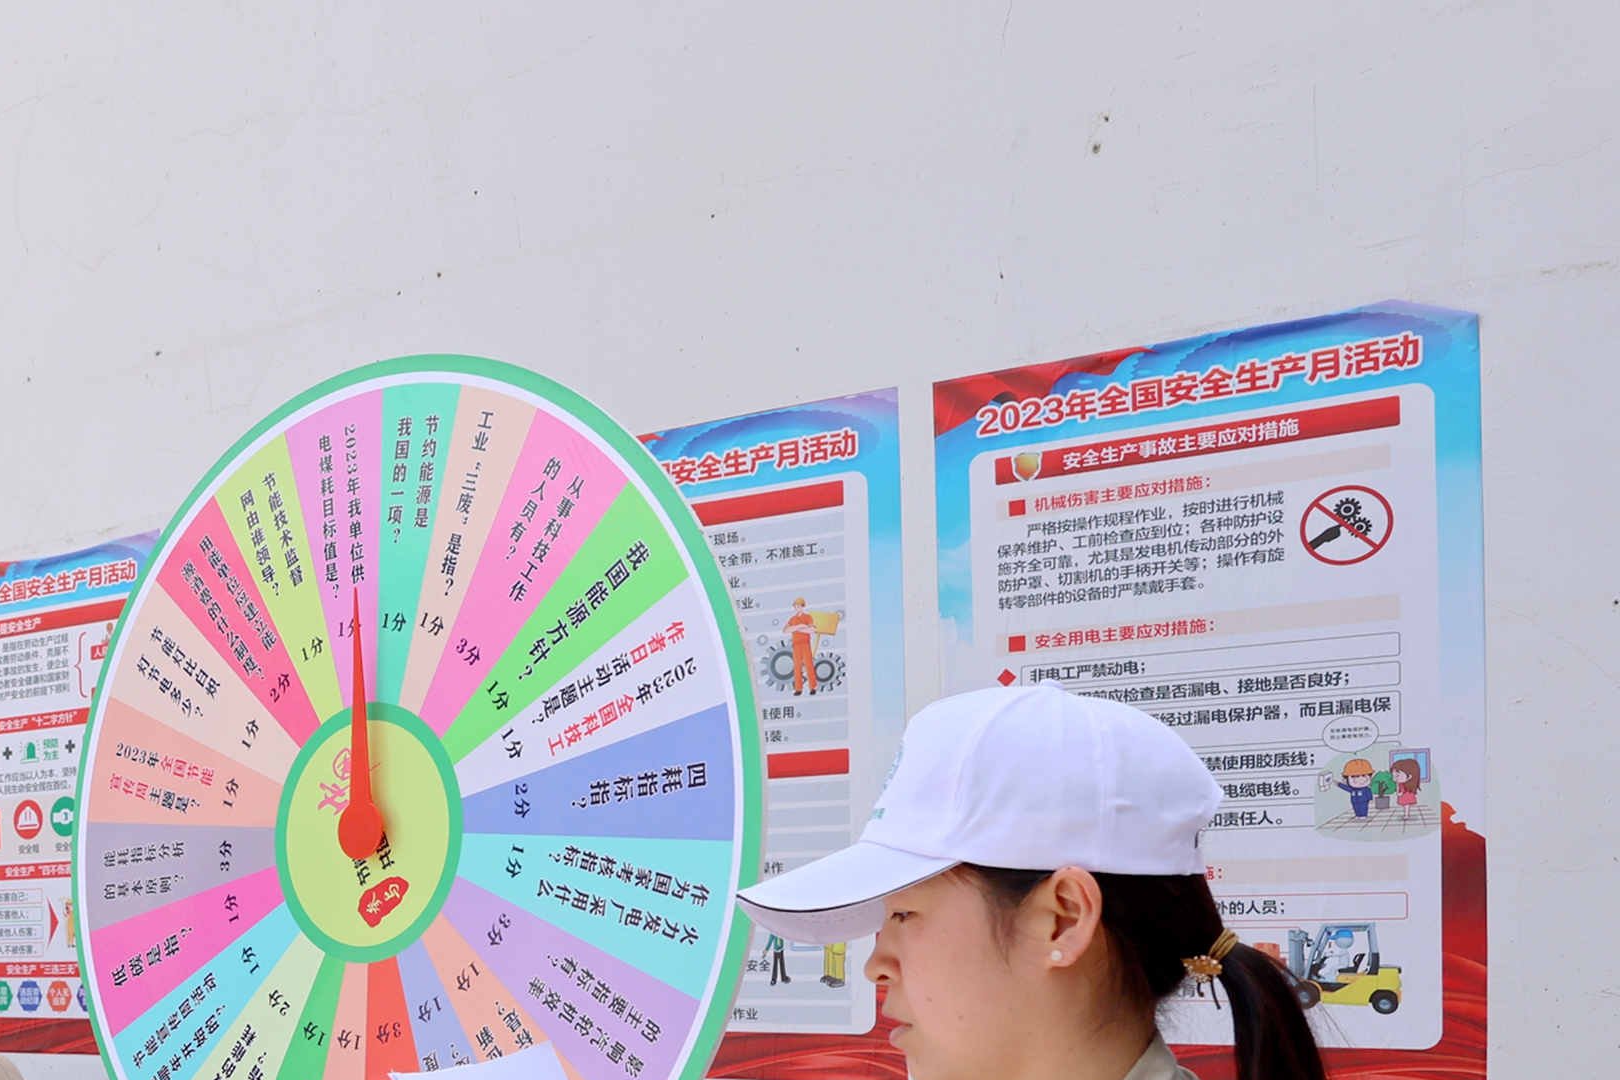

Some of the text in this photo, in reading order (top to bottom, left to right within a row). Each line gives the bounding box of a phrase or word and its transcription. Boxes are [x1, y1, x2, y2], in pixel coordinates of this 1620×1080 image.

[977, 335, 1420, 436] 2023年全国安全生产月活动
[1062, 419, 1300, 470] 安全生产事故主要应对措施
[387, 416, 413, 544] 我国的一项？
[414, 415, 440, 528] 节约能源是
[344, 423, 365, 584] 2023年我单位供
[441, 411, 494, 596] 工业“三废”是指？
[506, 456, 562, 560] 的人员有？
[1026, 491, 1284, 537] 严格按操作规程作业，按时进行机械
[1034, 477, 1211, 513] 机械伤害主要应对措施：
[262, 471, 303, 587] 节能技术监督
[318, 434, 340, 599] 电煤耗目标值是？
[997, 510, 1284, 559] 保养维护、工前检查应到位；各种防护设
[240, 489, 279, 596] 网由谁领导？
[509, 475, 585, 603] 从事科技工作
[709, 531, 746, 546] 现场。
[997, 530, 1284, 578] 施齐全可靠，尤其是发电机传动部分的外
[997, 548, 1285, 595] 防护罩、切割机的手柄开关等；操作有旋
[198, 534, 277, 652] 用能单位应建立能
[518, 539, 650, 681] 我国能源方针？
[997, 579, 1205, 611] 转零部件的设备时严禁戴手套。
[382, 612, 406, 632] 1分
[419, 612, 444, 636] 1分
[1034, 619, 1215, 650] 安全用电主要应对措施：
[150, 626, 221, 699] 节能灯比白炽
[301, 636, 324, 662] 1分
[455, 637, 482, 666] 3分
[136, 653, 204, 718] 灯节电多少？
[269, 673, 291, 703] 2分
[531, 620, 687, 725] 作者日活动主题是？
[1029, 661, 1146, 683] 非电工严禁动电；
[486, 680, 510, 711] 1分
[547, 657, 698, 757] 2023年全国科技工
[241, 719, 260, 750] 1分
[500, 727, 525, 760] 1分
[115, 742, 215, 787] 2023年全国节能
[110, 772, 200, 814] 宣传周主题是？
[222, 778, 240, 809] 1分
[513, 783, 531, 818] 2分
[571, 762, 708, 809] 四耗指标指？
[1219, 781, 1300, 798] 电缆电线。
[104, 841, 184, 867] 能耗指标分析
[219, 840, 232, 871] 3分
[505, 843, 525, 879] 1分
[104, 874, 184, 900] 的基本原则？
[548, 845, 711, 907] 作为国家考核指标？
[224, 894, 240, 923] 1分
[536, 878, 700, 946] 火力发电厂采用什么
[487, 913, 512, 946] 3分
[112, 926, 193, 987] 低碳是指？
[241, 946, 261, 975] 1分
[456, 961, 480, 992] 1分
[268, 990, 291, 1017] 2分
[418, 995, 442, 1023] 1分
[546, 954, 662, 1043] 的主要指标有？
[729, 1008, 758, 1021] 作业
[132, 972, 218, 1069] 节能宣传周活动
[303, 1021, 327, 1047] 1分
[337, 1029, 362, 1050] 1分
[376, 1022, 402, 1044] 3分
[527, 976, 646, 1078] 影响汽轮机效率
